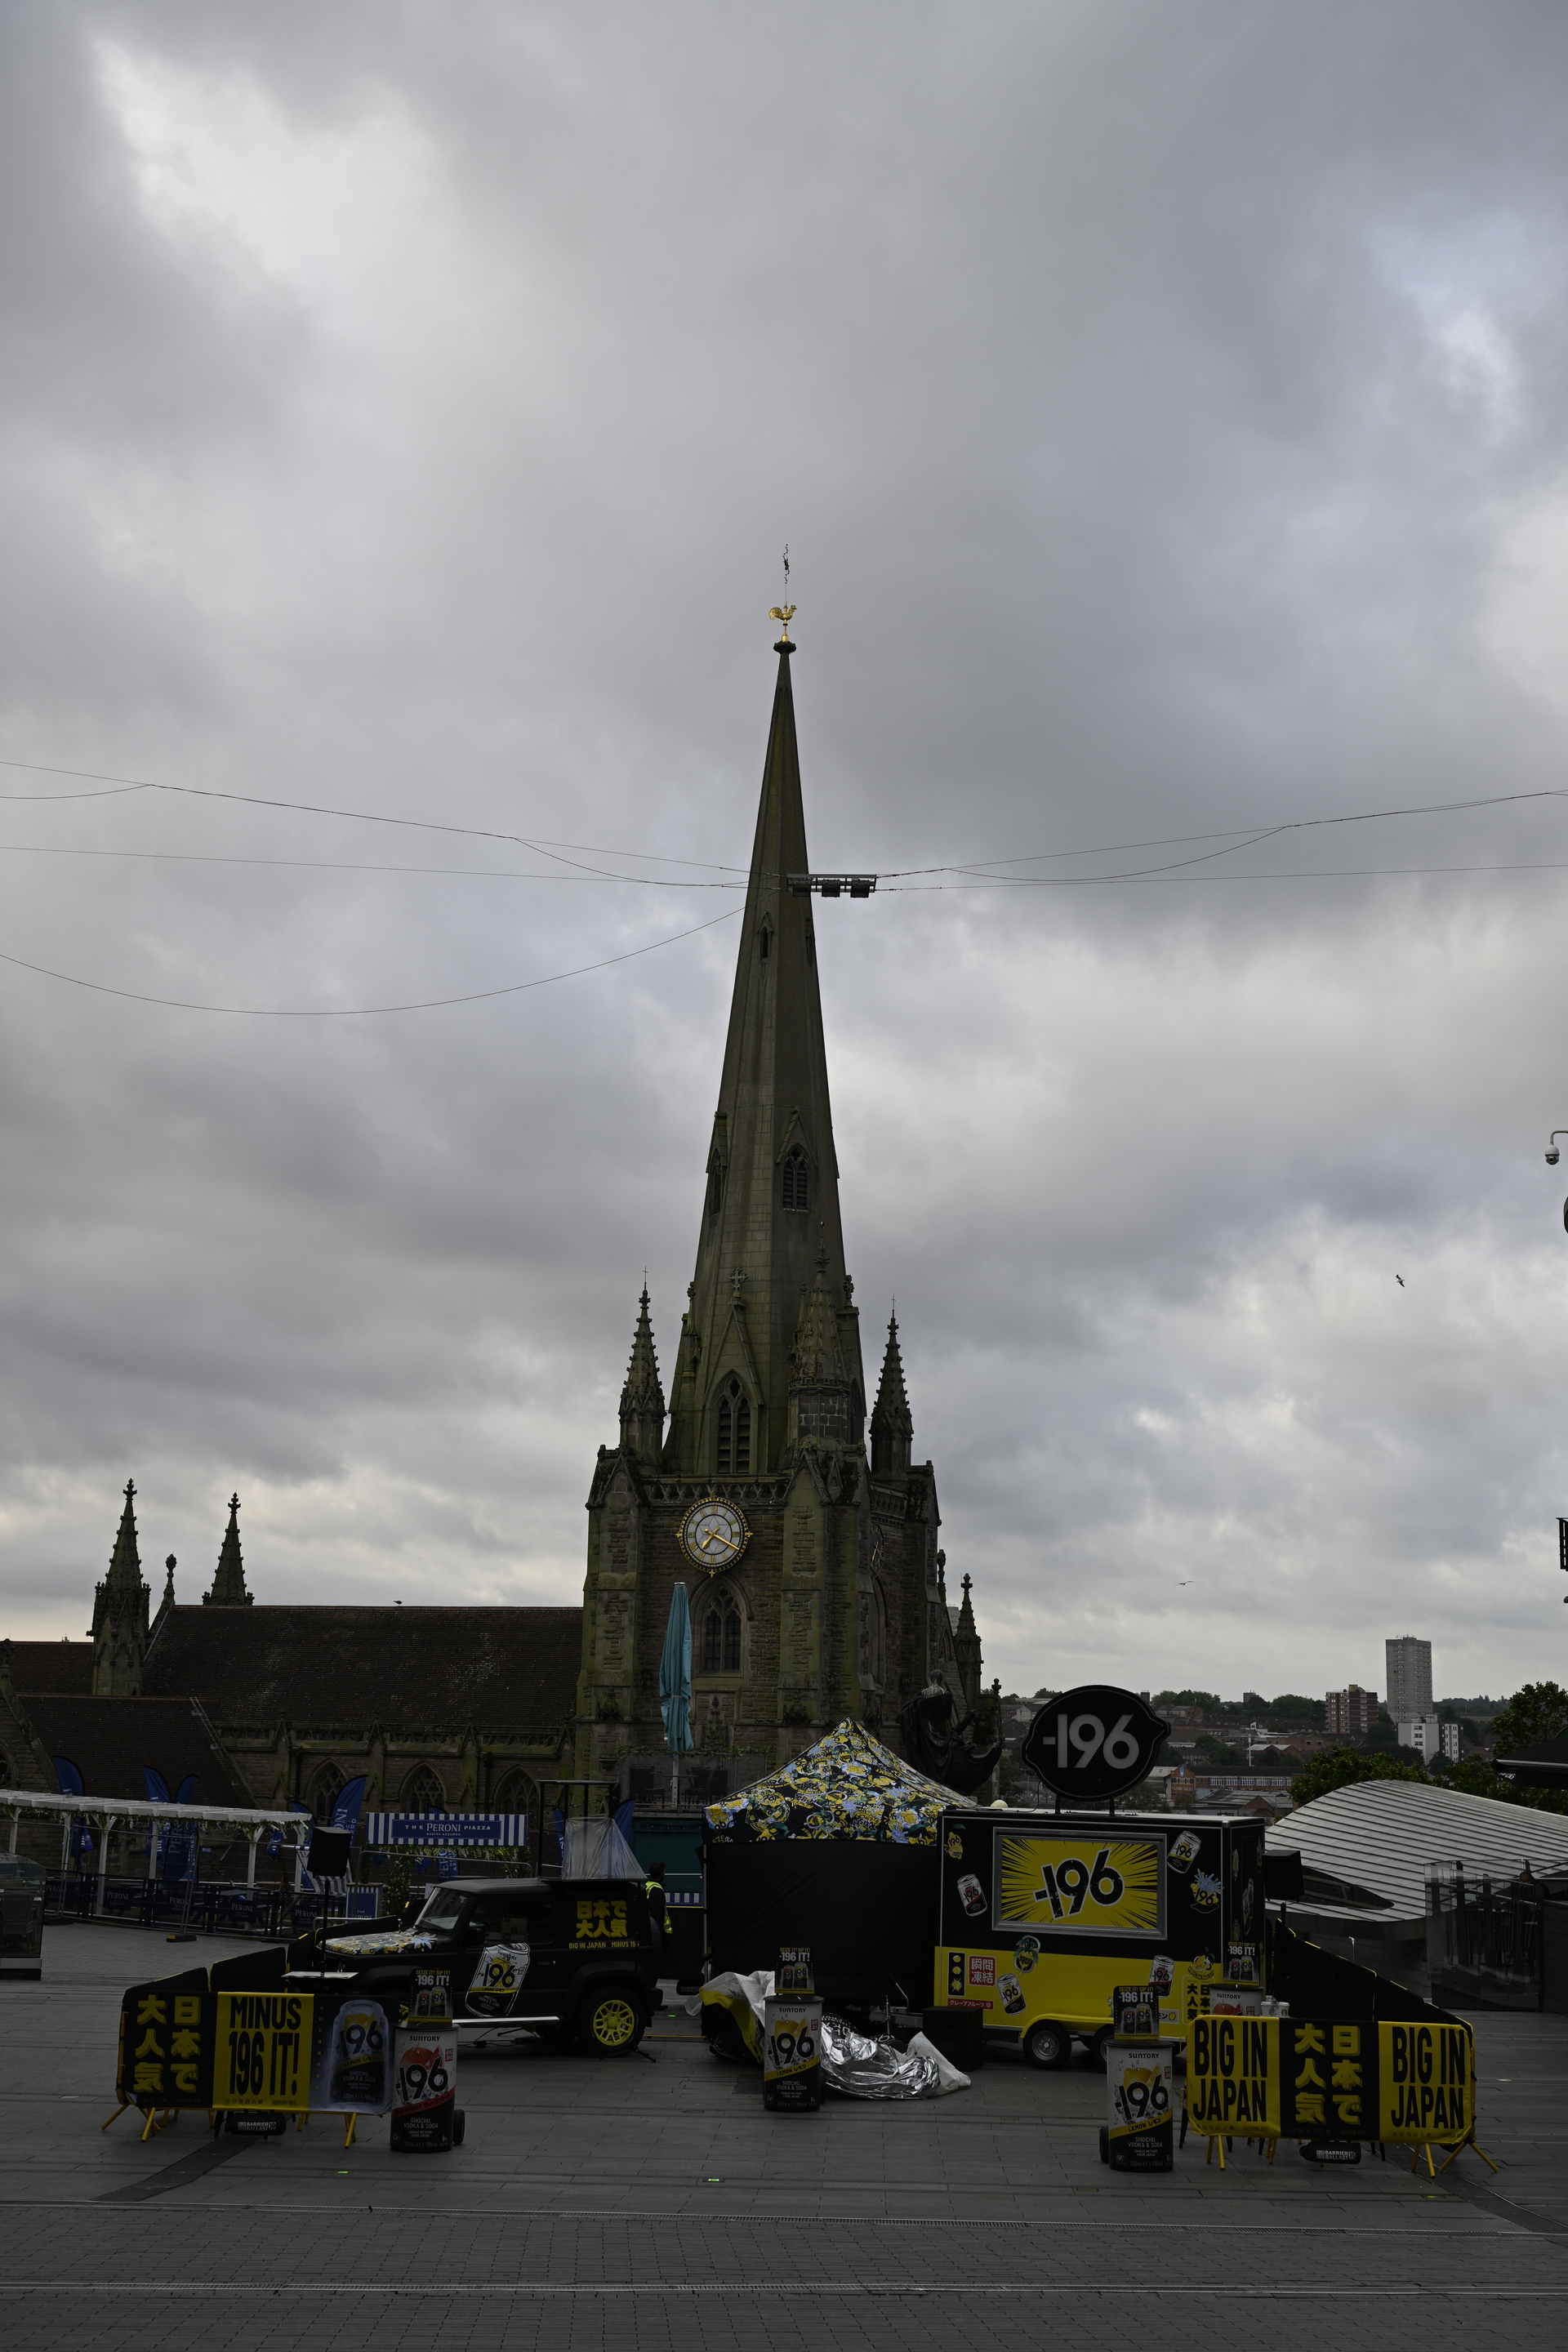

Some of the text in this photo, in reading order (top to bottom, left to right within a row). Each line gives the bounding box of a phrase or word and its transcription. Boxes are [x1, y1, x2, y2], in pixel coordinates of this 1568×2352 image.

[1042, 1713, 1140, 1770] -196
[426, 1823, 461, 1833] PERONI
[1033, 1847, 1125, 1919] -196
[107, 1891, 129, 1900] PERONI
[1193, 1887, 1214, 1905] -196
[231, 1903, 254, 1913] PERONI
[295, 1909, 318, 1918] PERONI
[577, 1900, 627, 1919] 日本で
[576, 1918, 628, 1939] 大人気
[779, 1952, 810, 1962] -196 IT!
[1227, 1946, 1255, 1956] -196 IT!
[971, 1958, 994, 1971] 瞬間
[415, 1975, 449, 1986] -196 IT!
[971, 1971, 994, 1984] 凍結
[1118, 1992, 1153, 2002] -196 IT!
[229, 1996, 302, 2030] MINUS
[133, 1993, 167, 2093] 大人気
[170, 1995, 202, 2094] 日本で
[768, 2026, 815, 2066] -196
[1194, 2020, 1267, 2078] BIG IN
[229, 2031, 265, 2096] 196
[270, 2032, 301, 2096] IT!
[344, 2058, 361, 2068] LEMON
[1392, 2026, 1465, 2086] BIG IN
[396, 2056, 448, 2102] -196
[777, 2064, 807, 2076] LEMON レモン
[1294, 2023, 1326, 2125] 大人気
[1331, 2025, 1363, 2126] 日本で
[1115, 2074, 1169, 2121] -196
[1192, 2078, 1267, 2123] JAPAN
[1391, 2085, 1464, 2129] JAPAN
[394, 2105, 422, 2115] GRAPEFRUIT
[1128, 2118, 1162, 2132] LEMON レモン
